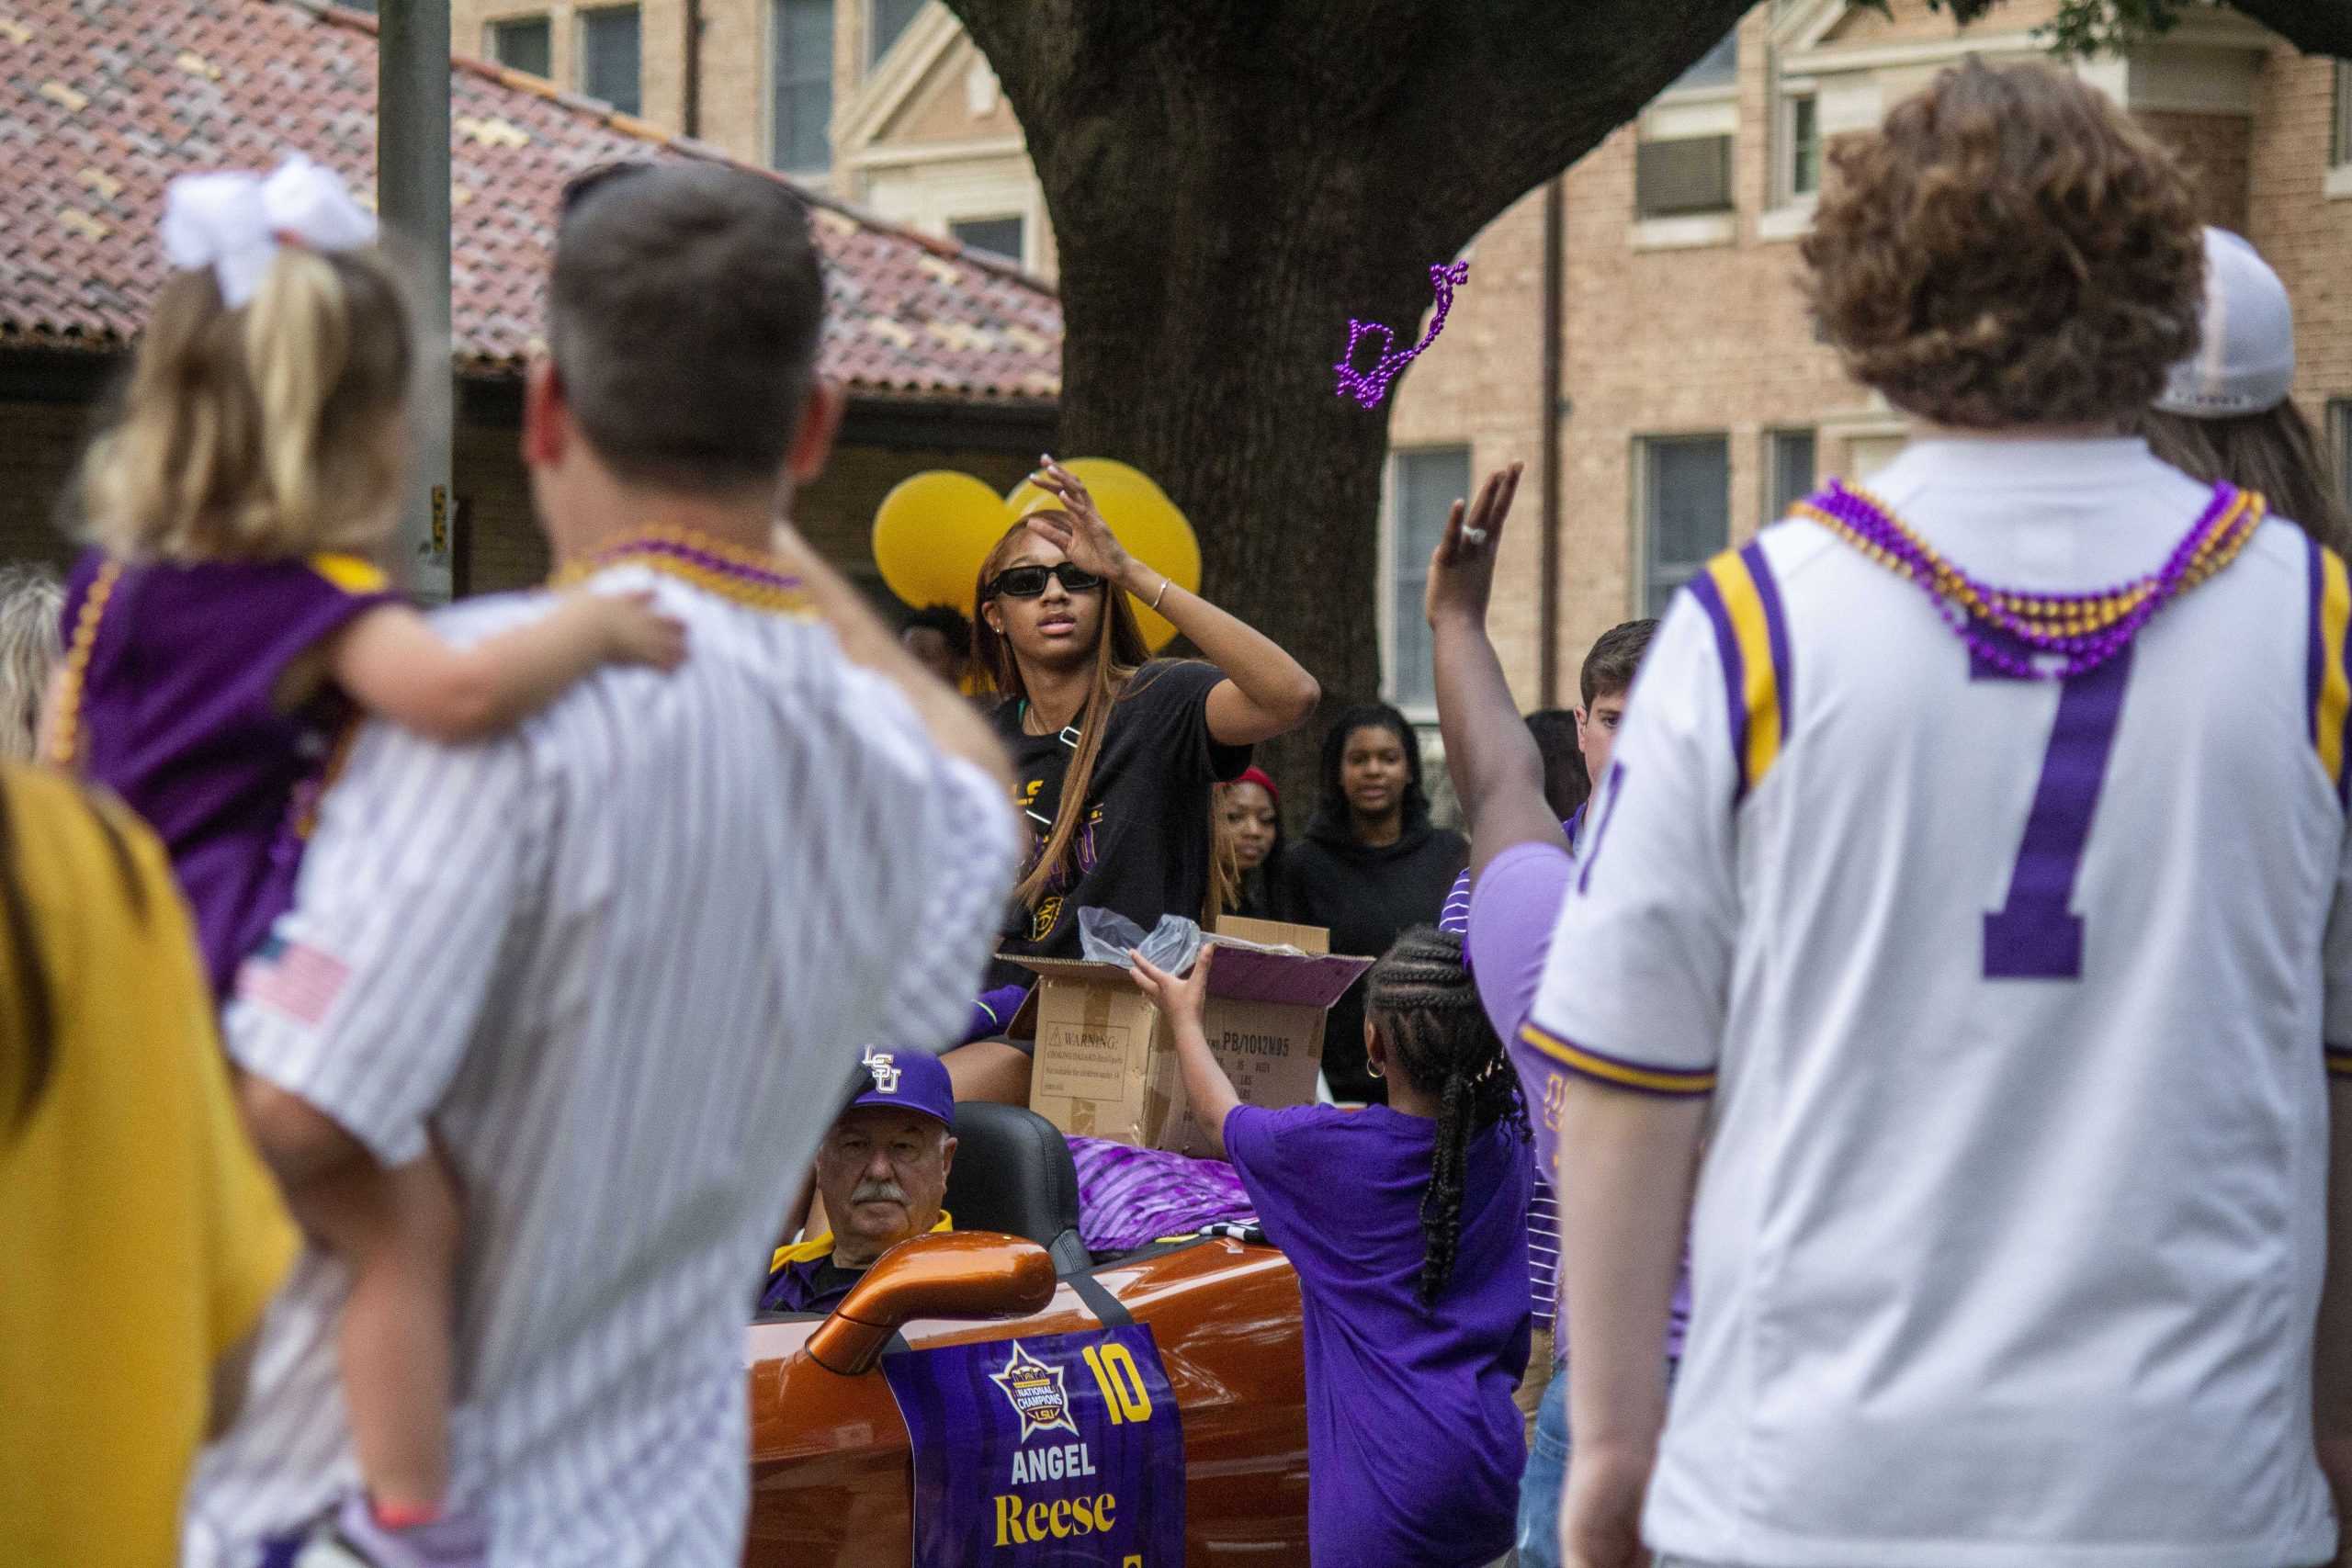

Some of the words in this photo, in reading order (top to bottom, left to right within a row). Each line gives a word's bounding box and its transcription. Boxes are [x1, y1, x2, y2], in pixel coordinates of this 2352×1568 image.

[1968, 602, 2138, 981] 7
[862, 1043, 901, 1094] LSU
[1017, 1385, 1054, 1398] NATIONAL
[1017, 1393, 1063, 1410] CHAMPIONS
[1081, 1343, 1152, 1425] 10
[1035, 1409, 1055, 1420] LSU
[1011, 1443, 1096, 1485] ANGEL
[992, 1493, 1116, 1548] Reese
